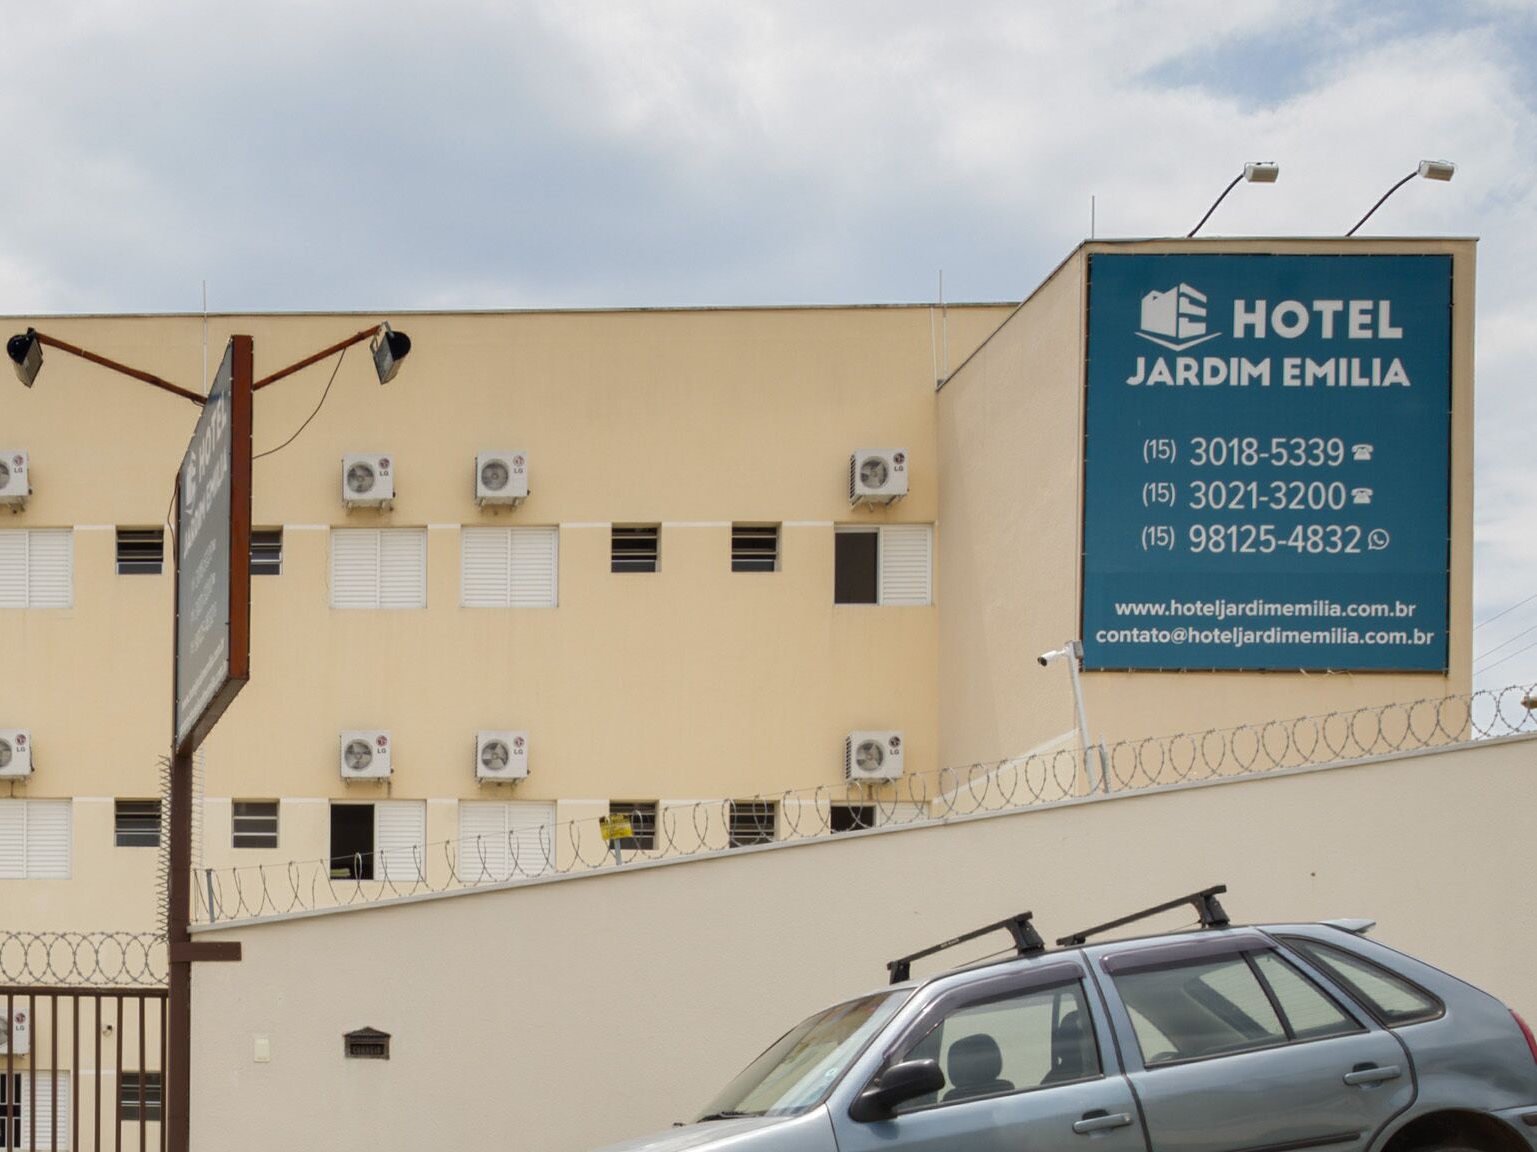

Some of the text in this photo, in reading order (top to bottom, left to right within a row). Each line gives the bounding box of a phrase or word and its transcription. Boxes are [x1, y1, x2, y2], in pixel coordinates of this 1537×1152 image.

[1233, 299, 1404, 339] HOTEL
[1126, 356, 1412, 388] JARDIM EMILIA
[198, 389, 227, 483] HOTEL
[1143, 436, 1345, 467] (15) 3018-5339
[1142, 480, 1347, 511] (15) 3021-3200
[1141, 524, 1362, 554] (15) 98125-4832
[1114, 599, 1417, 620] www.hoteljardimemilia.com.br
[1095, 626, 1435, 648] contato@hoteljardimemilia.com.br
